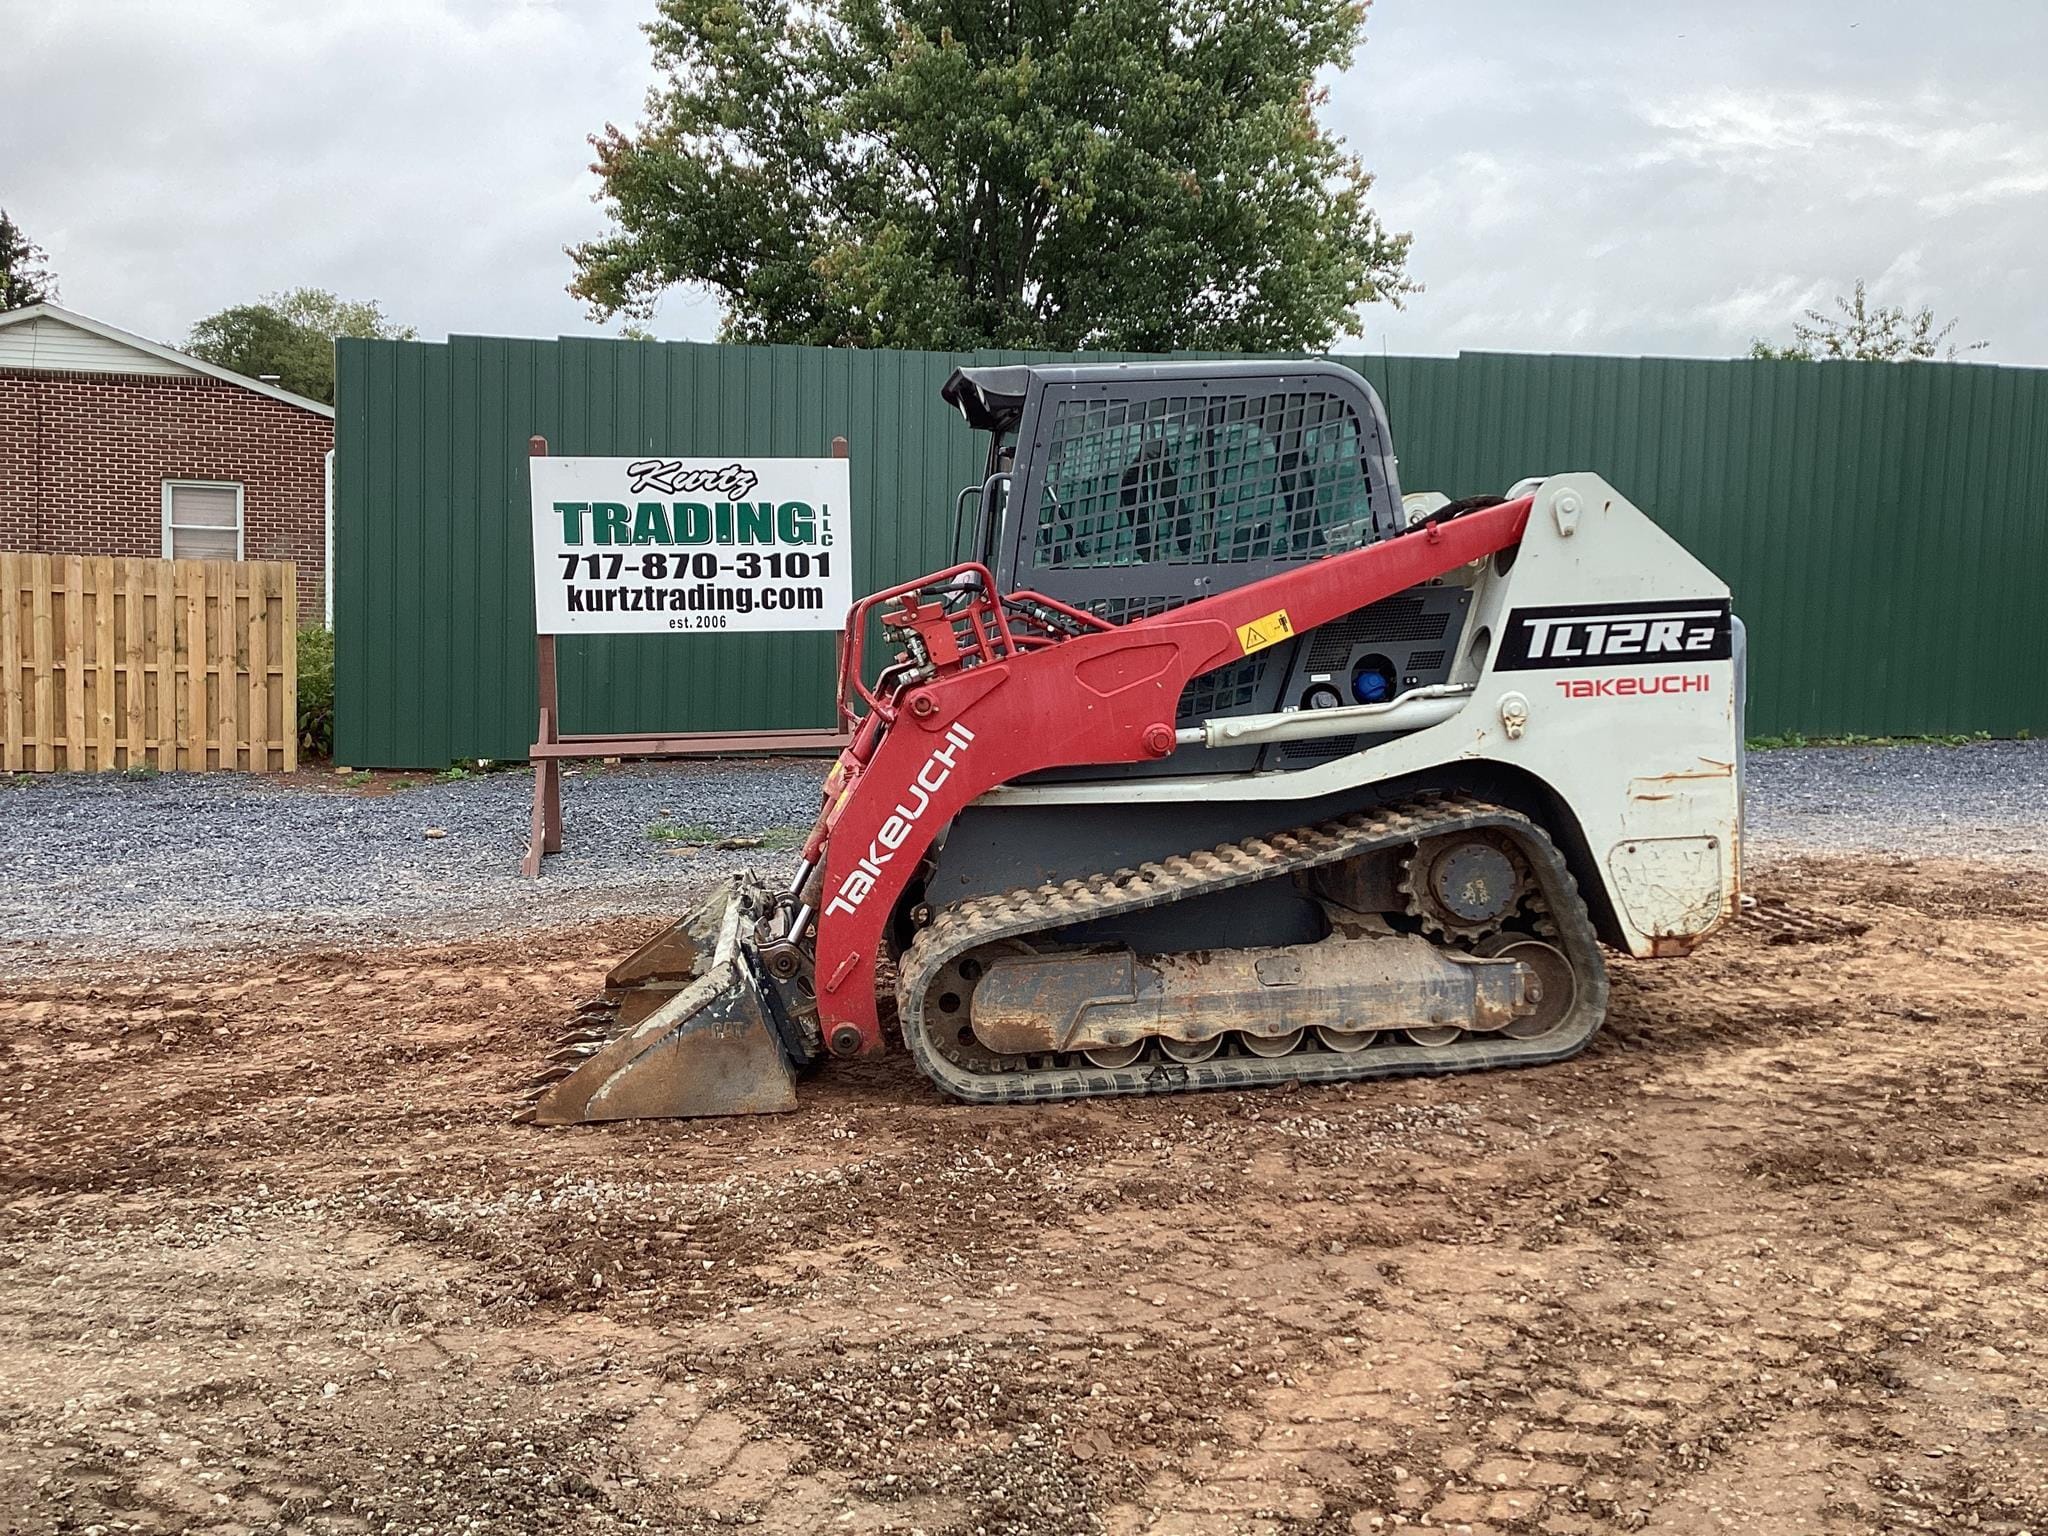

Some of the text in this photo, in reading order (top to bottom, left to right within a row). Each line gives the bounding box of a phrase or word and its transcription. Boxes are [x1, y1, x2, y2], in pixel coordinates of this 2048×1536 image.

[627, 460, 758, 501] Kurtz
[553, 501, 817, 546] TRADING
[558, 552, 830, 580] 717-870-3101
[567, 583, 823, 613] kurtztrading.com
[669, 616, 727, 629] est. 2006
[1523, 610, 1722, 658] TL12R2
